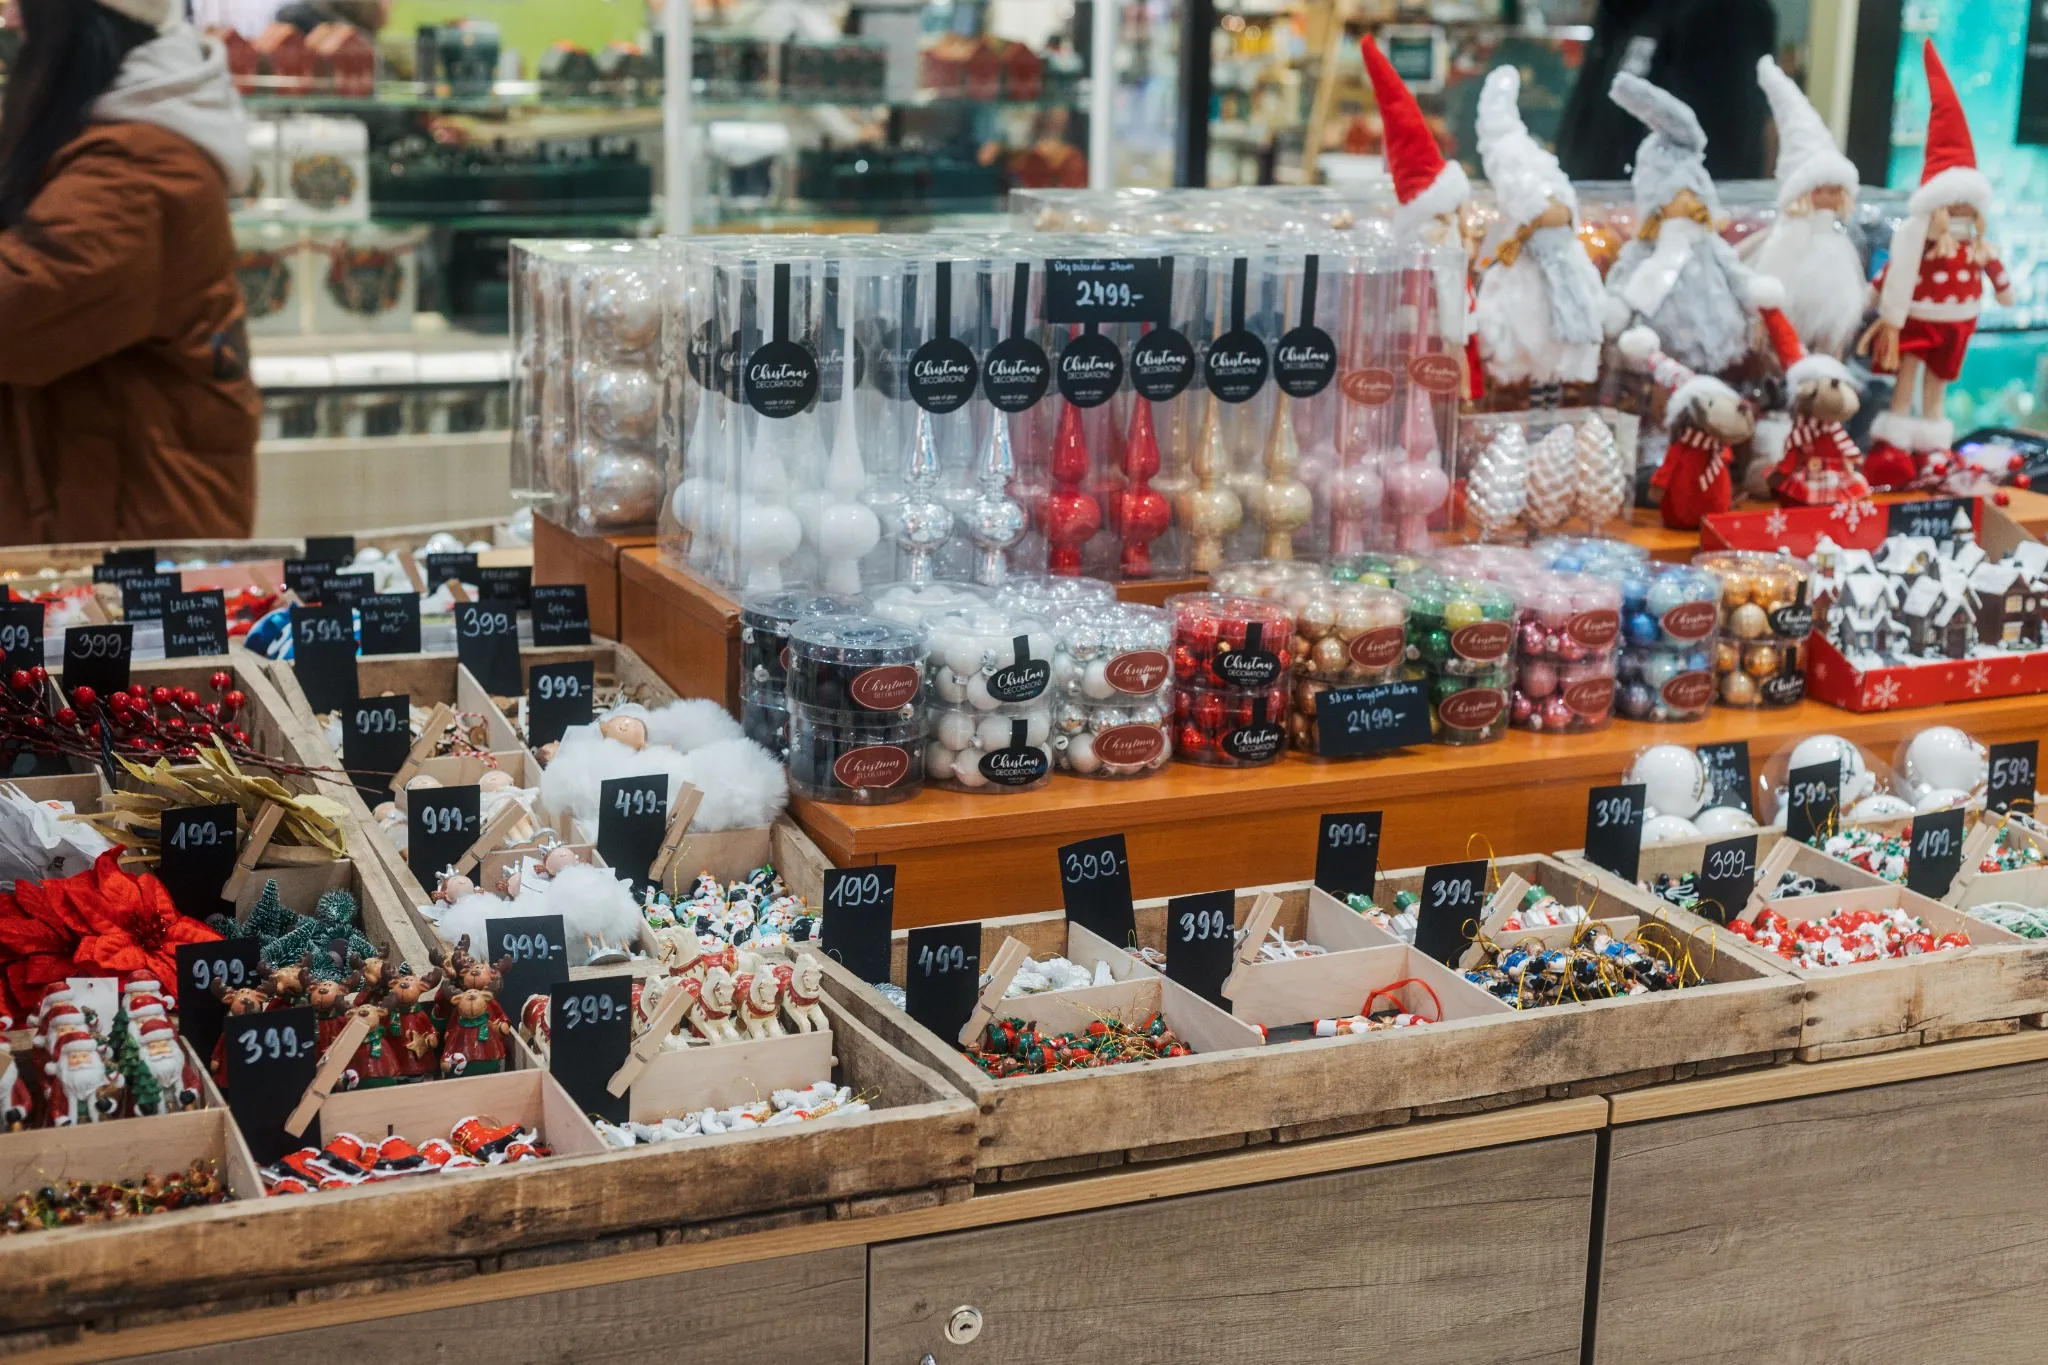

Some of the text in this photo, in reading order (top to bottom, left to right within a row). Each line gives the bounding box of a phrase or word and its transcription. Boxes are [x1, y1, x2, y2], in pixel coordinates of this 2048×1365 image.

[1076, 280, 1144, 307] 2499.-
[1062, 355, 1118, 372] Christmas
[1135, 349, 1188, 367] Christmas
[1210, 351, 1262, 368] Christmas
[1279, 347, 1331, 362] Christmas
[751, 363, 810, 381] Christmas
[914, 359, 970, 377] Christmas
[989, 359, 1043, 376] Christmas
[993, 375, 1036, 384] DECORATIONS
[756, 380, 803, 389] DECORATIONS
[920, 376, 964, 385] DECORATIONS
[300, 619, 353, 644] 599.-
[463, 608, 517, 637] 399.-
[71, 633, 130, 659] 399.-
[1113, 661, 1163, 676] Christmas
[1224, 654, 1274, 670] Christmas
[538, 675, 590, 700] 999.-
[861, 677, 913, 692] Christmas
[997, 668, 1045, 688] Christmas
[1004, 680, 1042, 694] DECORATIONS
[356, 708, 408, 734] 999.-
[1347, 707, 1407, 733] 2499.-
[1103, 736, 1155, 750] Christmas
[1234, 729, 1279, 746] Christmas
[843, 757, 899, 773] Christmas
[856, 769, 892, 779] DECORATION
[991, 754, 1040, 769] Christmas
[1992, 757, 2035, 789] 599.-
[615, 790, 667, 817] 499.-
[1793, 781, 1838, 807] 599.-
[422, 806, 476, 834] 999.-
[1597, 797, 1642, 827] 399.-
[170, 822, 233, 850] 199.-
[1328, 822, 1378, 847] 999.-
[1917, 828, 1959, 859] 199.-
[1066, 850, 1126, 884] 399.-
[1708, 849, 1755, 880] 399.-
[828, 873, 893, 907] 199.-
[1431, 878, 1484, 907] 399.-
[1180, 910, 1234, 942] 399.-
[503, 933, 562, 963] 999.-
[918, 945, 978, 977] 499.-
[192, 958, 257, 990] 999.-
[562, 994, 628, 1029] 399.-
[238, 1026, 314, 1064] 399.-
